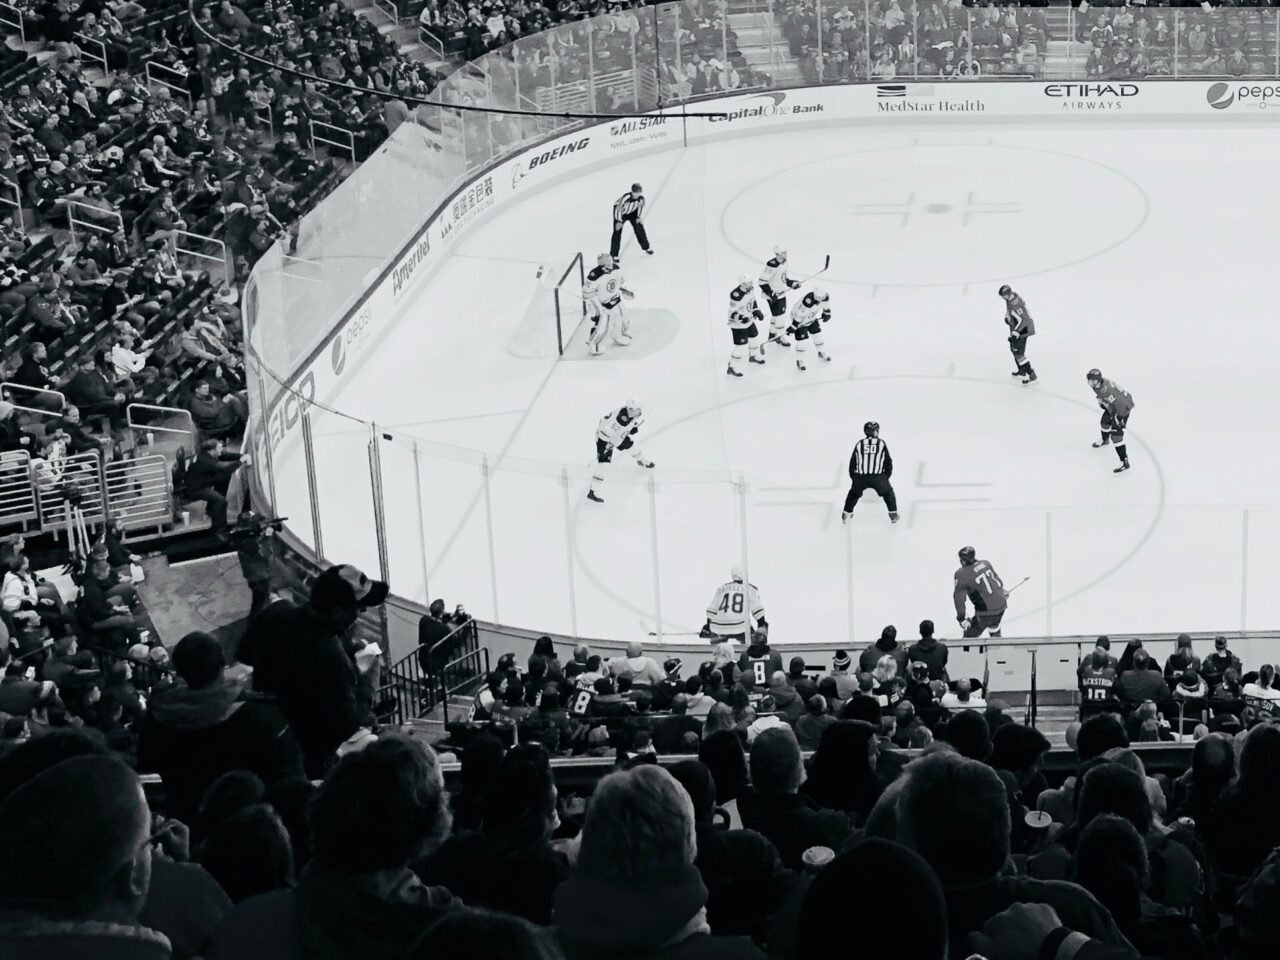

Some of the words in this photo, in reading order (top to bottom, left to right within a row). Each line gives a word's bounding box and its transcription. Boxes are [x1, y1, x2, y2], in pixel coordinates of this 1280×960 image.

[1044, 84, 1139, 97] ETIHAD
[792, 103, 824, 114] Bank
[877, 100, 935, 112] MedStar
[939, 100, 985, 111] Health
[1062, 101, 1122, 109] AIRWAYS
[529, 137, 590, 170] BOEING
[392, 233, 430, 296] Ameritel
[863, 445, 877, 454] 50
[718, 593, 745, 614] 48
[753, 661, 766, 685] 8
[574, 690, 591, 714] 8
